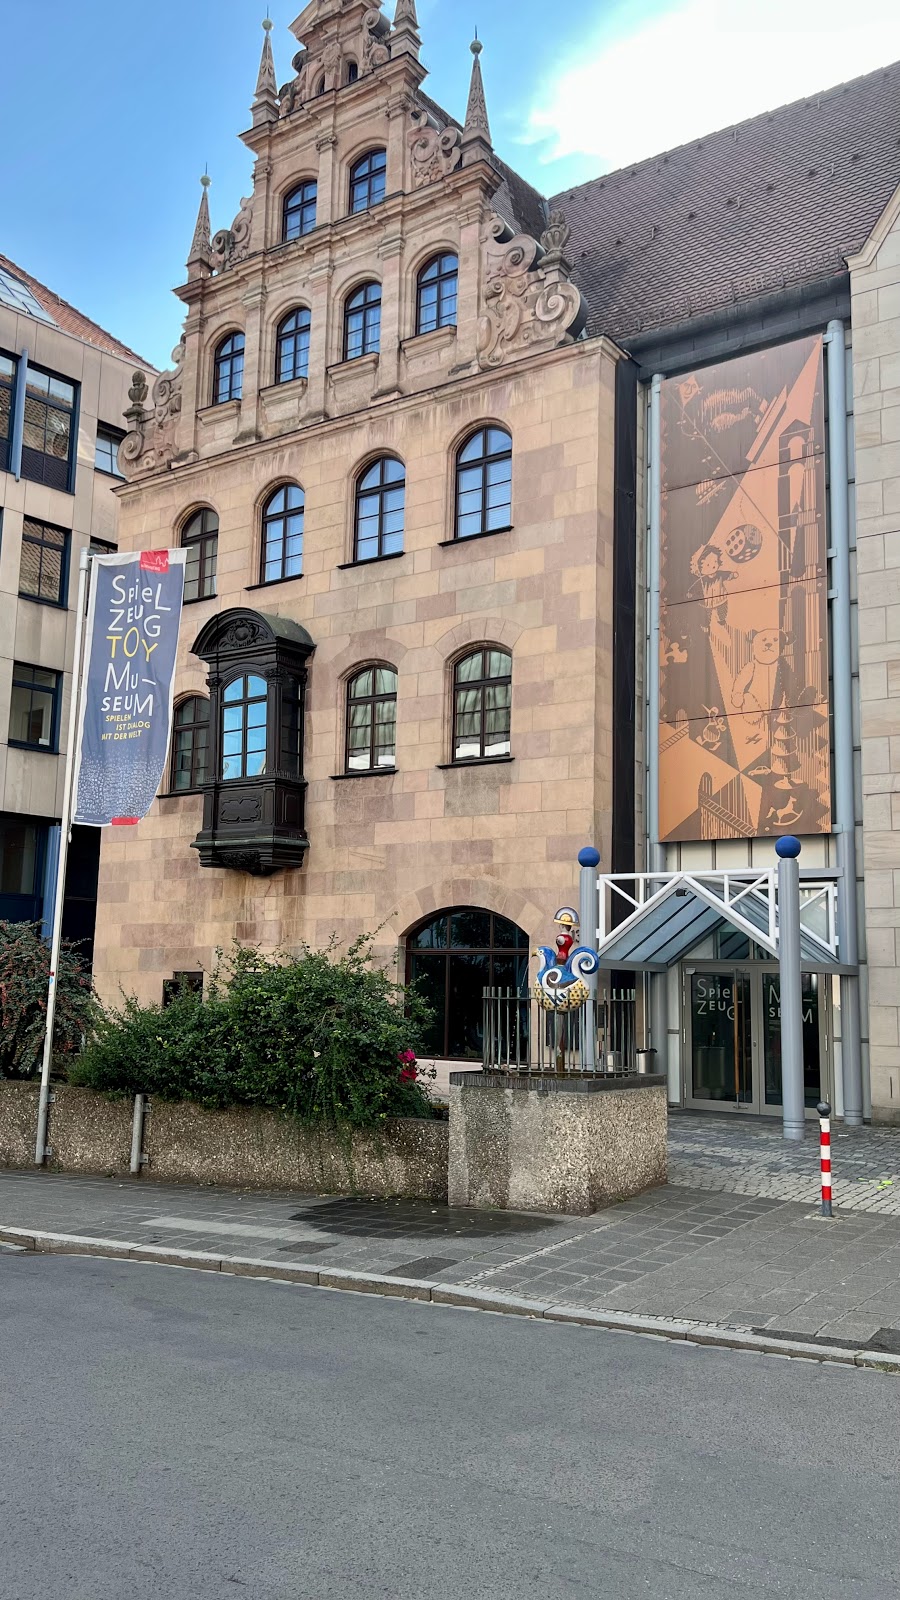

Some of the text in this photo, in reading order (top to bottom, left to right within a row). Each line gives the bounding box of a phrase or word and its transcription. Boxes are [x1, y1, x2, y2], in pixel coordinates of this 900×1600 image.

[108, 604, 161, 637] ZEUG
[106, 626, 158, 662] TOY
[101, 693, 154, 716] SEUM
[105, 714, 131, 722] SPIELEN
[116, 720, 151, 731] IST DIALOG
[128, 730, 142, 739] WELT
[769, 1007, 813, 1024] SEM
